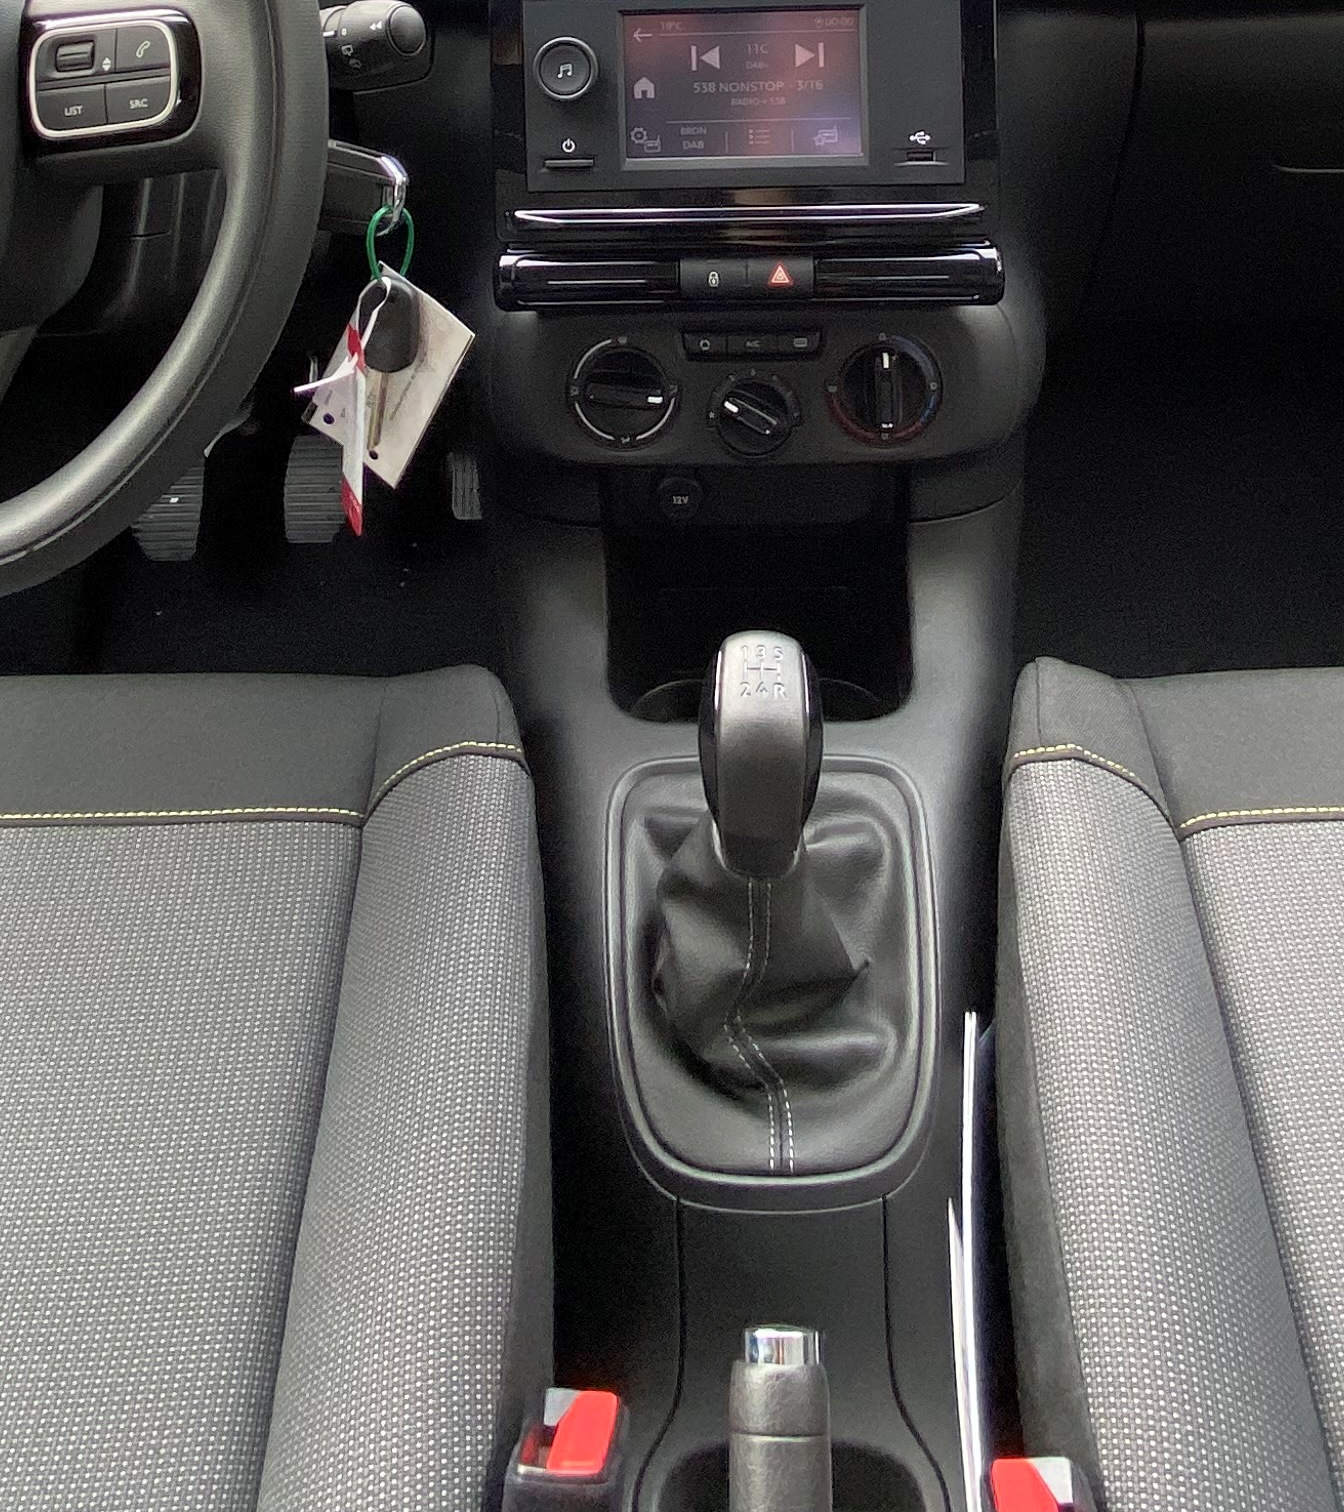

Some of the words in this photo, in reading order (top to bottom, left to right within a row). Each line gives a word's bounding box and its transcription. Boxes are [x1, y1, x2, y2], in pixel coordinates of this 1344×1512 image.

[693, 82, 716, 93] 538
[718, 80, 785, 92] NONSTOP
[64, 105, 84, 117] LIST
[129, 98, 149, 110] SRC
[672, 495, 689, 505] 12V
[773, 682, 787, 699] R
